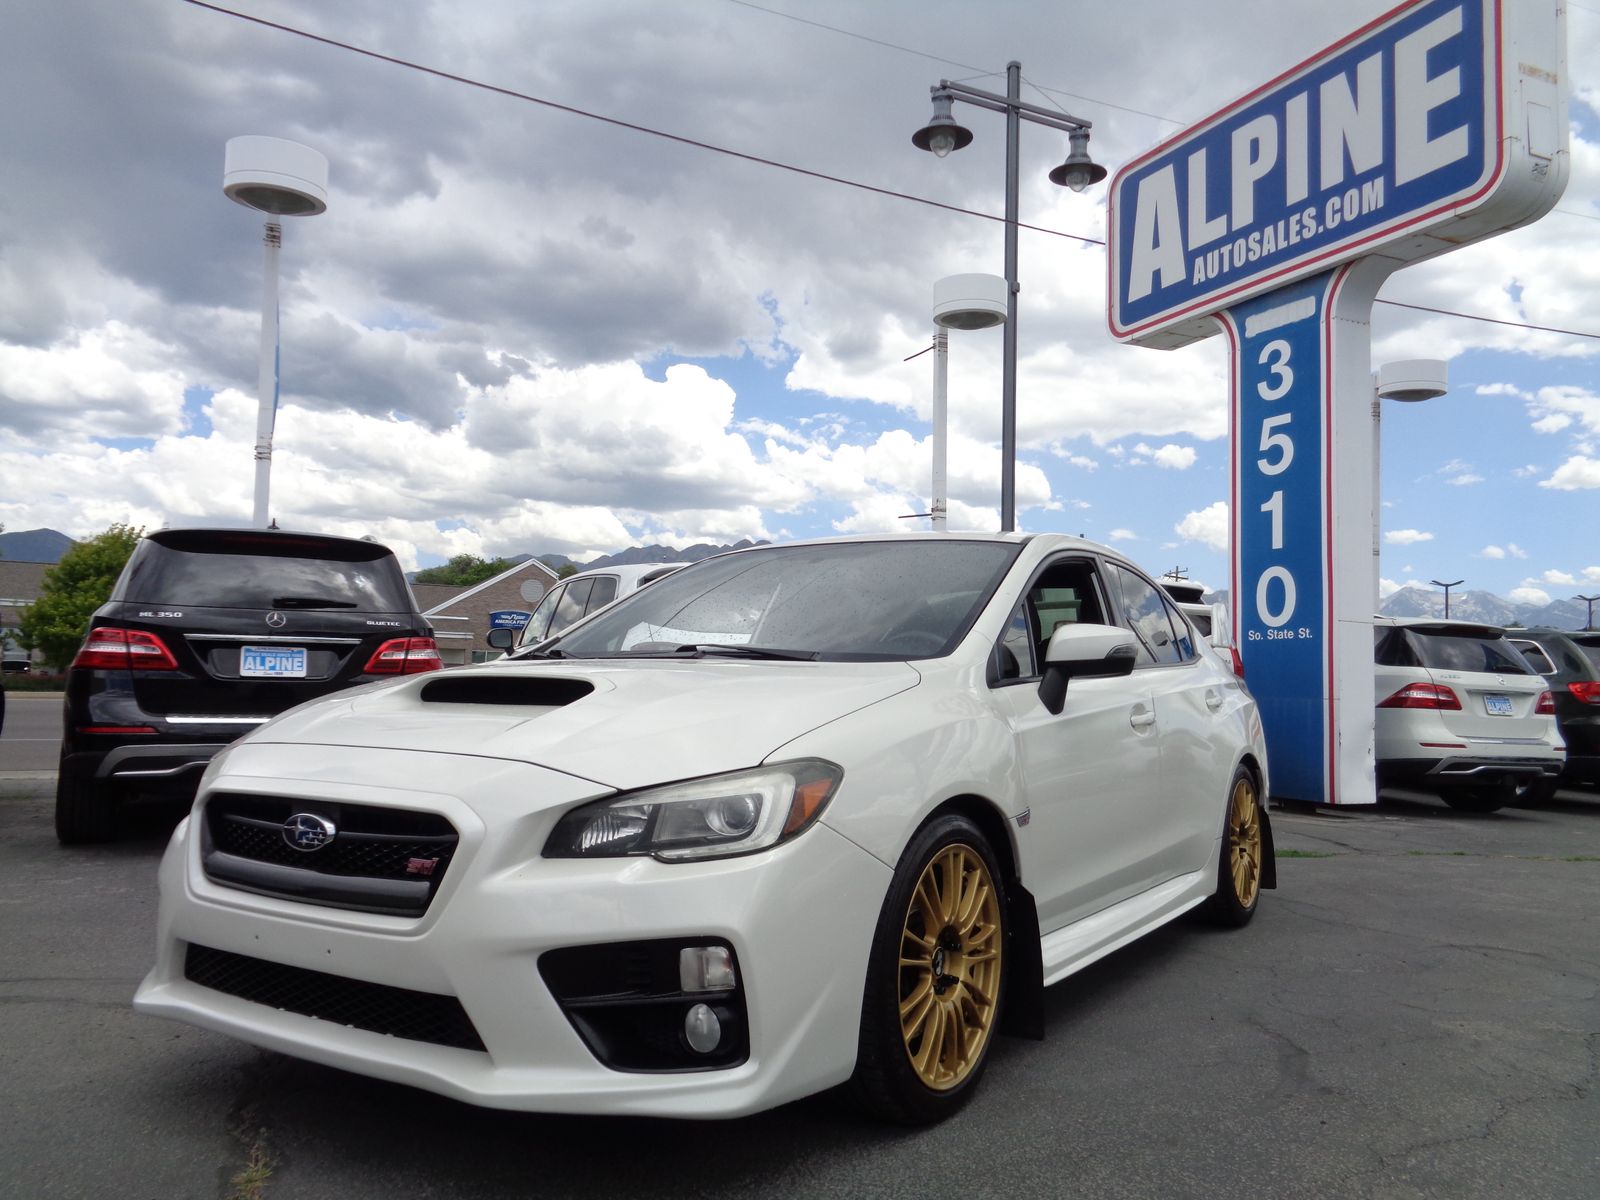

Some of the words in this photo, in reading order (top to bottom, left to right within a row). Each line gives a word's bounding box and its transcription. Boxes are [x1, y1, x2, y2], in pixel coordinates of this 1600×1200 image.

[1127, 4, 1470, 304] ALPINE
[1192, 175, 1386, 286] AUTOSALES.COM
[1248, 630, 1264, 641] So.
[1267, 629, 1294, 640] State
[1298, 627, 1313, 639] St.
[244, 656, 304, 672] ALPINE
[1487, 701, 1512, 712] ALPINE
